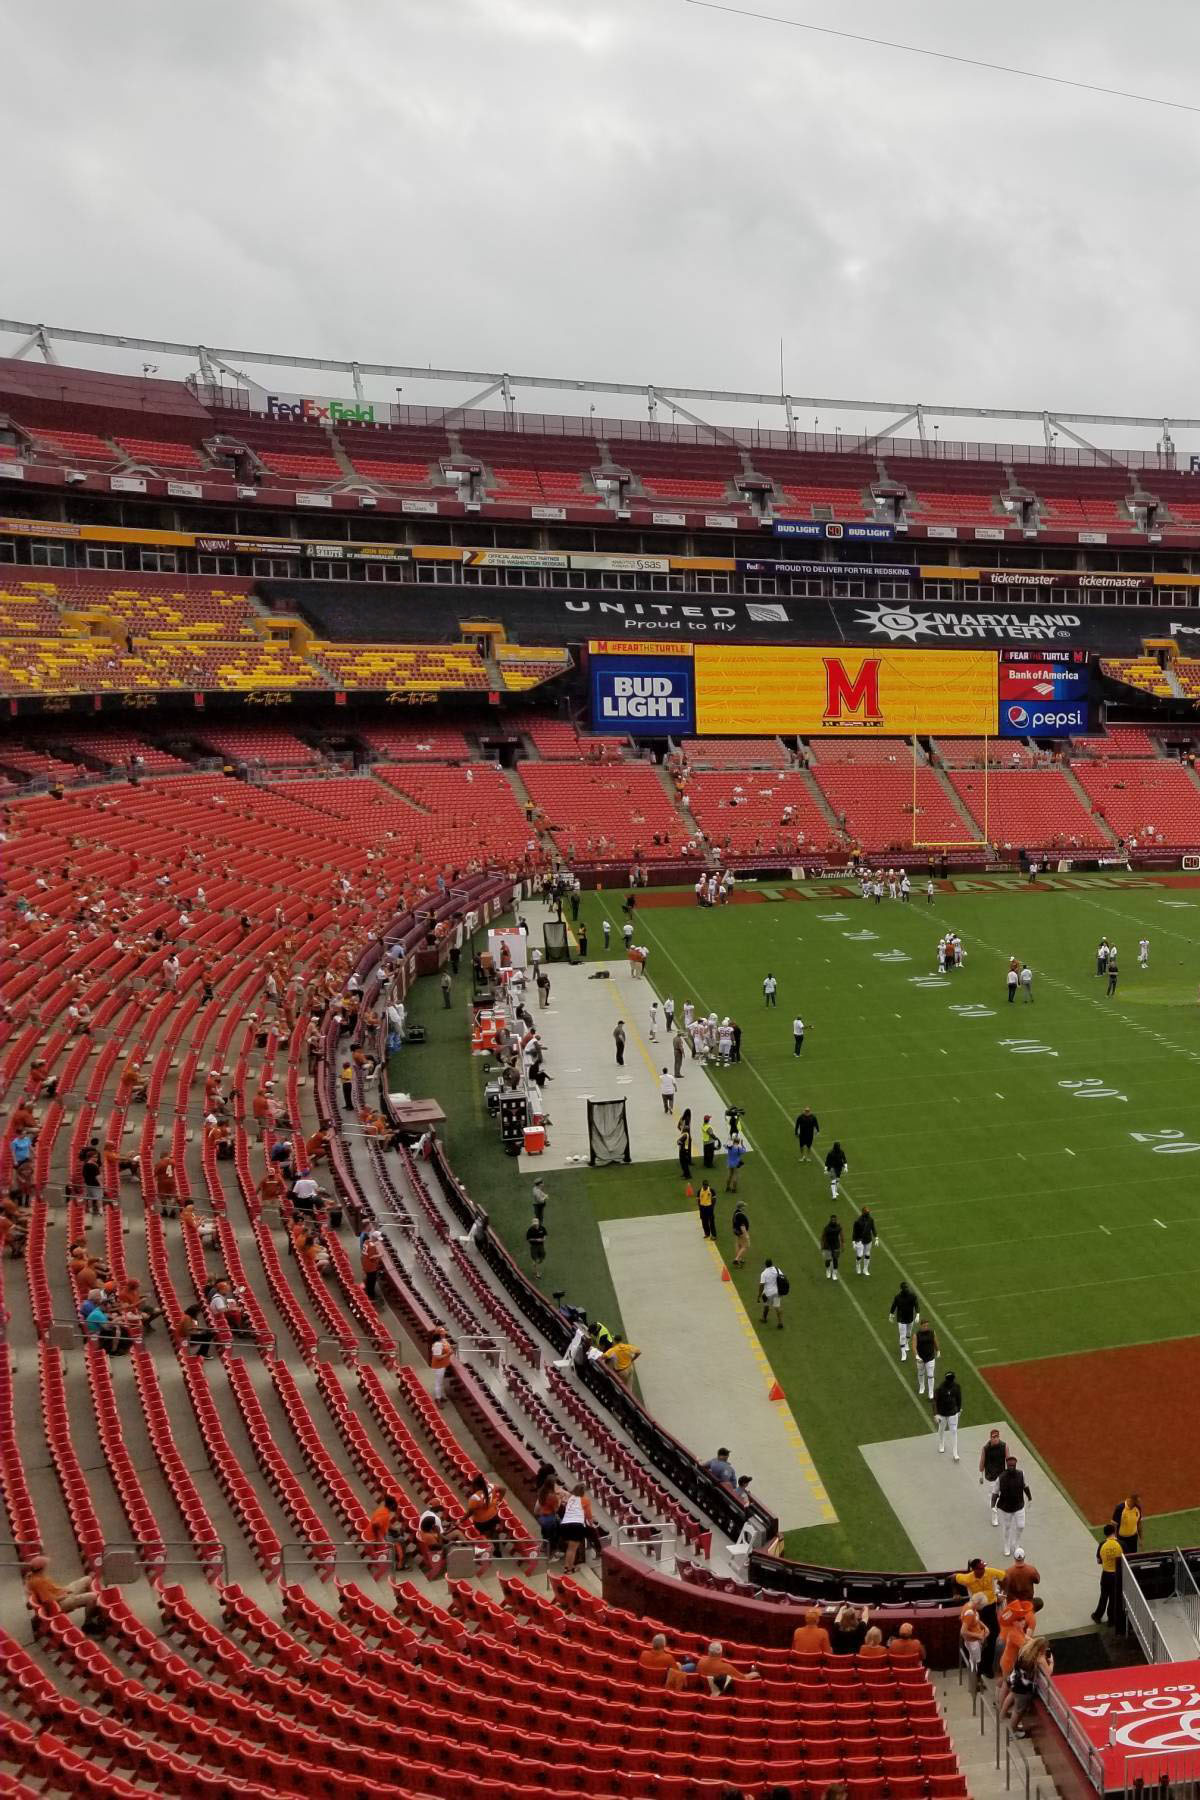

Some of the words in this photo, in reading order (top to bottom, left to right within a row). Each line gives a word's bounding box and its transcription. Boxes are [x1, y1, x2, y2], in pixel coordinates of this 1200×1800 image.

[267, 395, 374, 422] FedExField
[777, 525, 795, 533] BUD
[795, 526, 820, 534] LIGHT
[828, 526, 841, 536] 40
[867, 529, 890, 537] LIGHT
[644, 559, 662, 569] sas
[776, 564, 801, 572] PROUD
[802, 565, 812, 573] TO
[812, 565, 843, 574] DELIVER
[844, 566, 859, 574] FOR
[859, 567, 873, 575] THE
[991, 572, 1055, 585] ticketmaster
[1079, 576, 1142, 588] ticketmaster
[565, 601, 736, 618] UNITED
[625, 619, 681, 630] Proud
[688, 621, 707, 631] to
[714, 620, 736, 632] fly
[933, 611, 1081, 627] MARYLAND
[938, 625, 1057, 640] LOTTERY
[1008, 669, 1031, 680] Bank
[1032, 669, 1043, 680] of
[1042, 670, 1079, 681] America
[614, 676, 673, 697] BUD
[822, 657, 884, 718] M
[603, 696, 684, 717] LIGHT
[1033, 709, 1082, 728] pepsi
[947, 1003, 998, 1018] 50
[998, 1037, 1053, 1054] 40
[1057, 1077, 1120, 1099] 30
[1083, 1688, 1157, 1701] Places
[1163, 1684, 1195, 1694] Go
